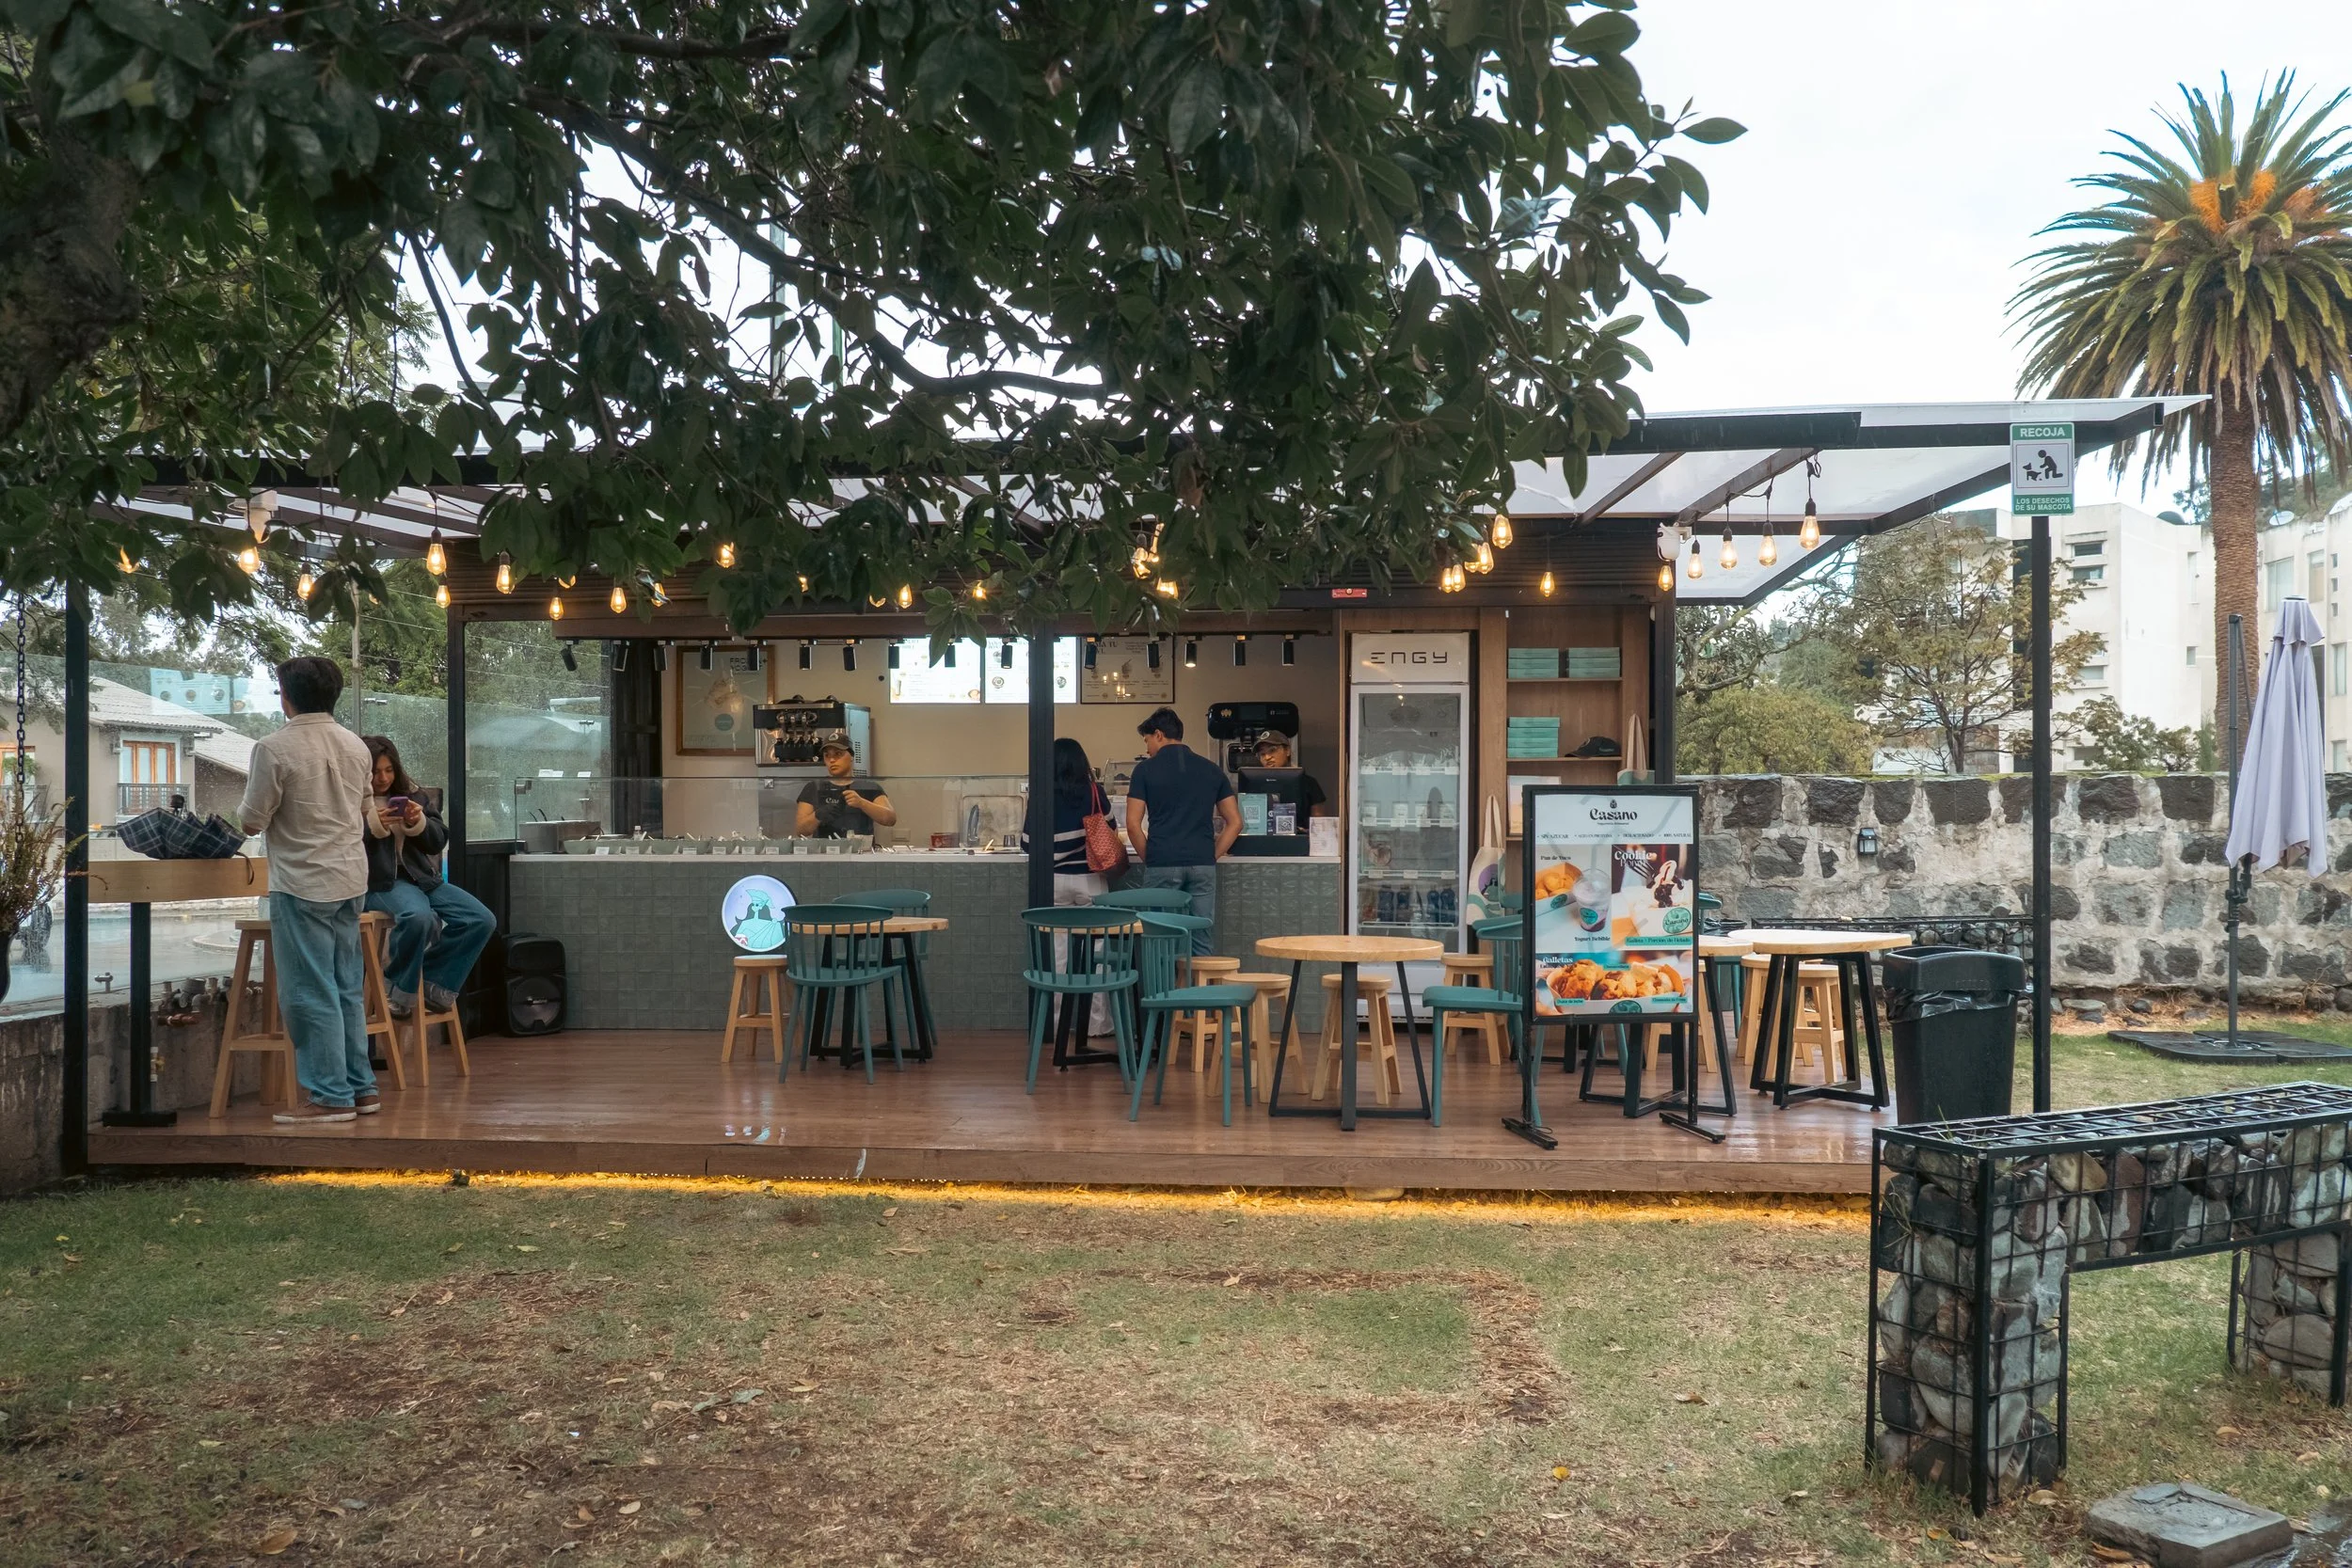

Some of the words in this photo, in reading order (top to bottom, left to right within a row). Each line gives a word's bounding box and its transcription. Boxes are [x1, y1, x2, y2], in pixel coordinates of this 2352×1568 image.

[2020, 427, 2065, 437] RECOJA
[1371, 651, 1447, 664] ENGY
[1589, 808, 1638, 821] Casano
[1613, 849, 1652, 861] Cookie
[1542, 956, 1573, 964] Galletas
